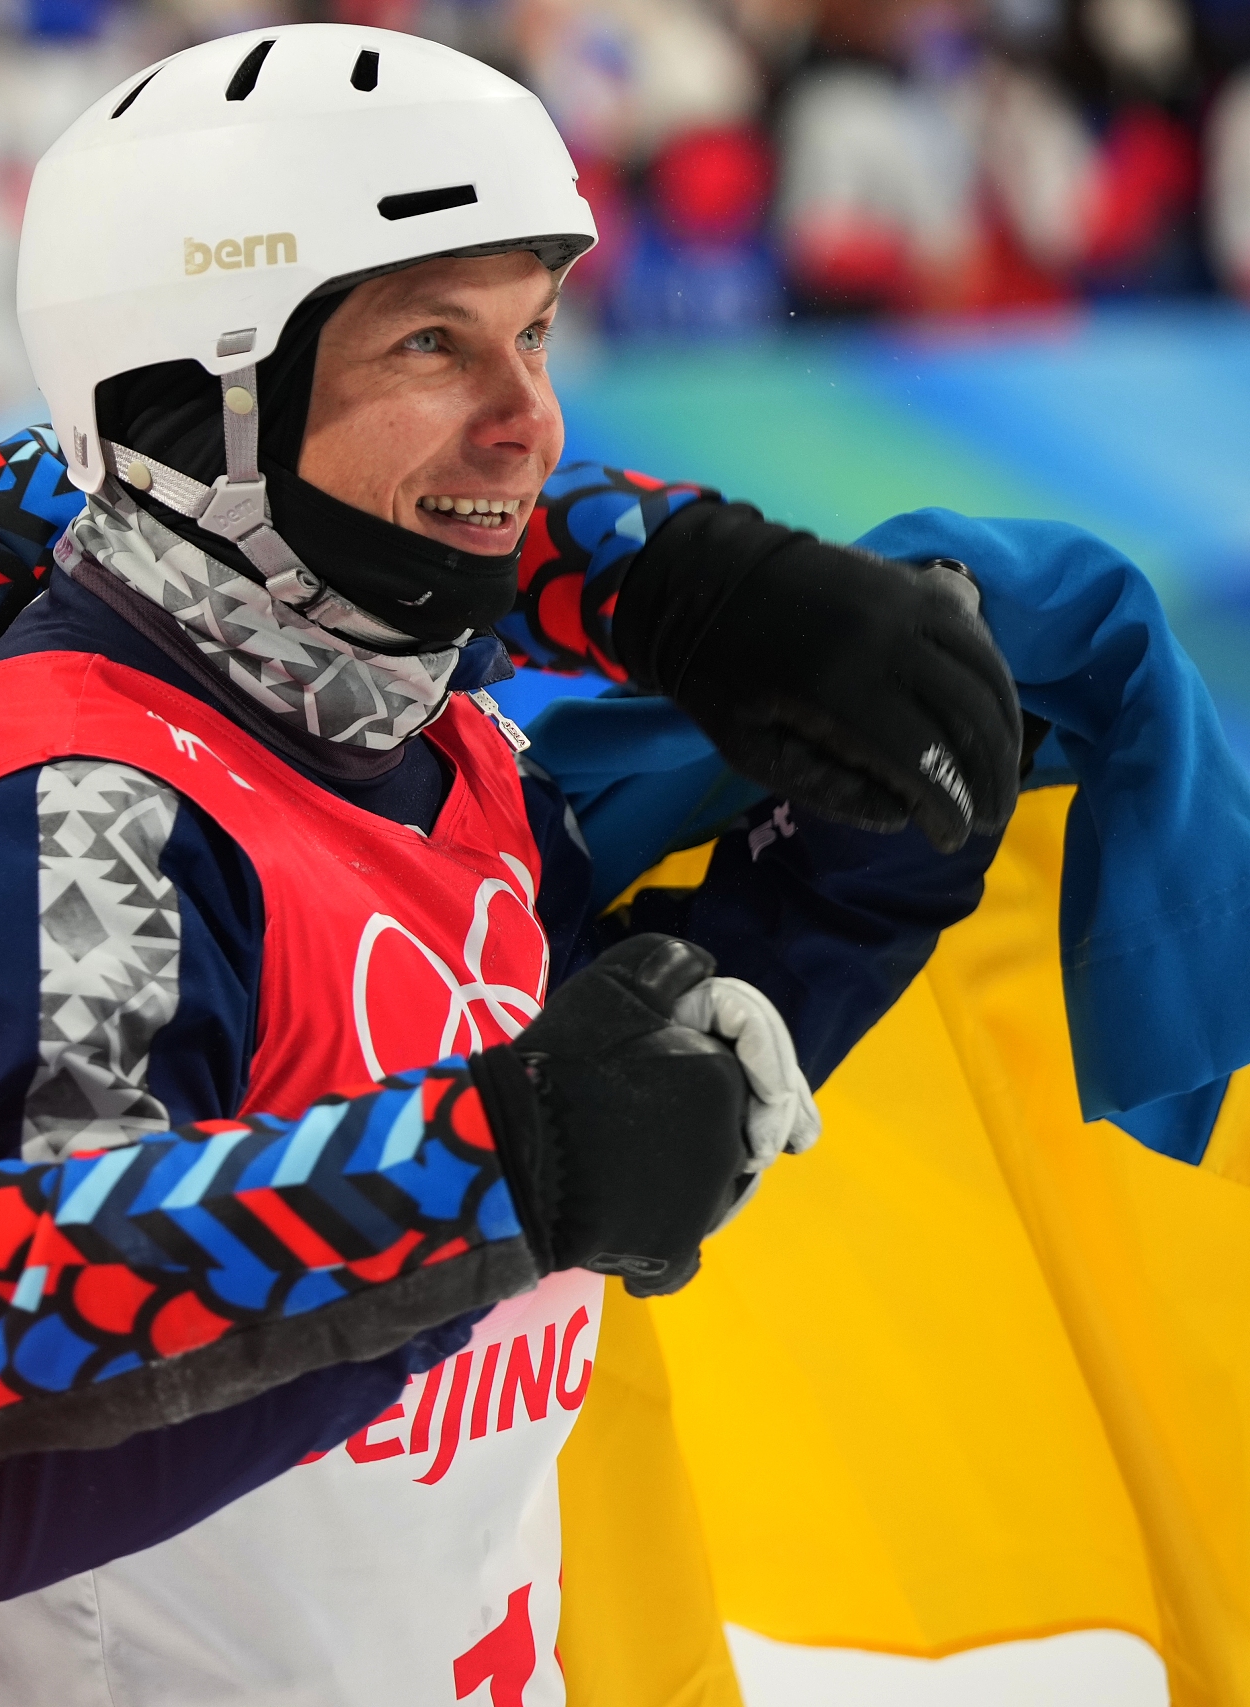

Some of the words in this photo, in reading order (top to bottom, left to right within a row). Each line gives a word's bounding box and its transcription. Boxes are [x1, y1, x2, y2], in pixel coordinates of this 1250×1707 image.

[183, 232, 297, 276] bern
[213, 498, 259, 532] bern
[295, 1305, 593, 1486] EIJING
